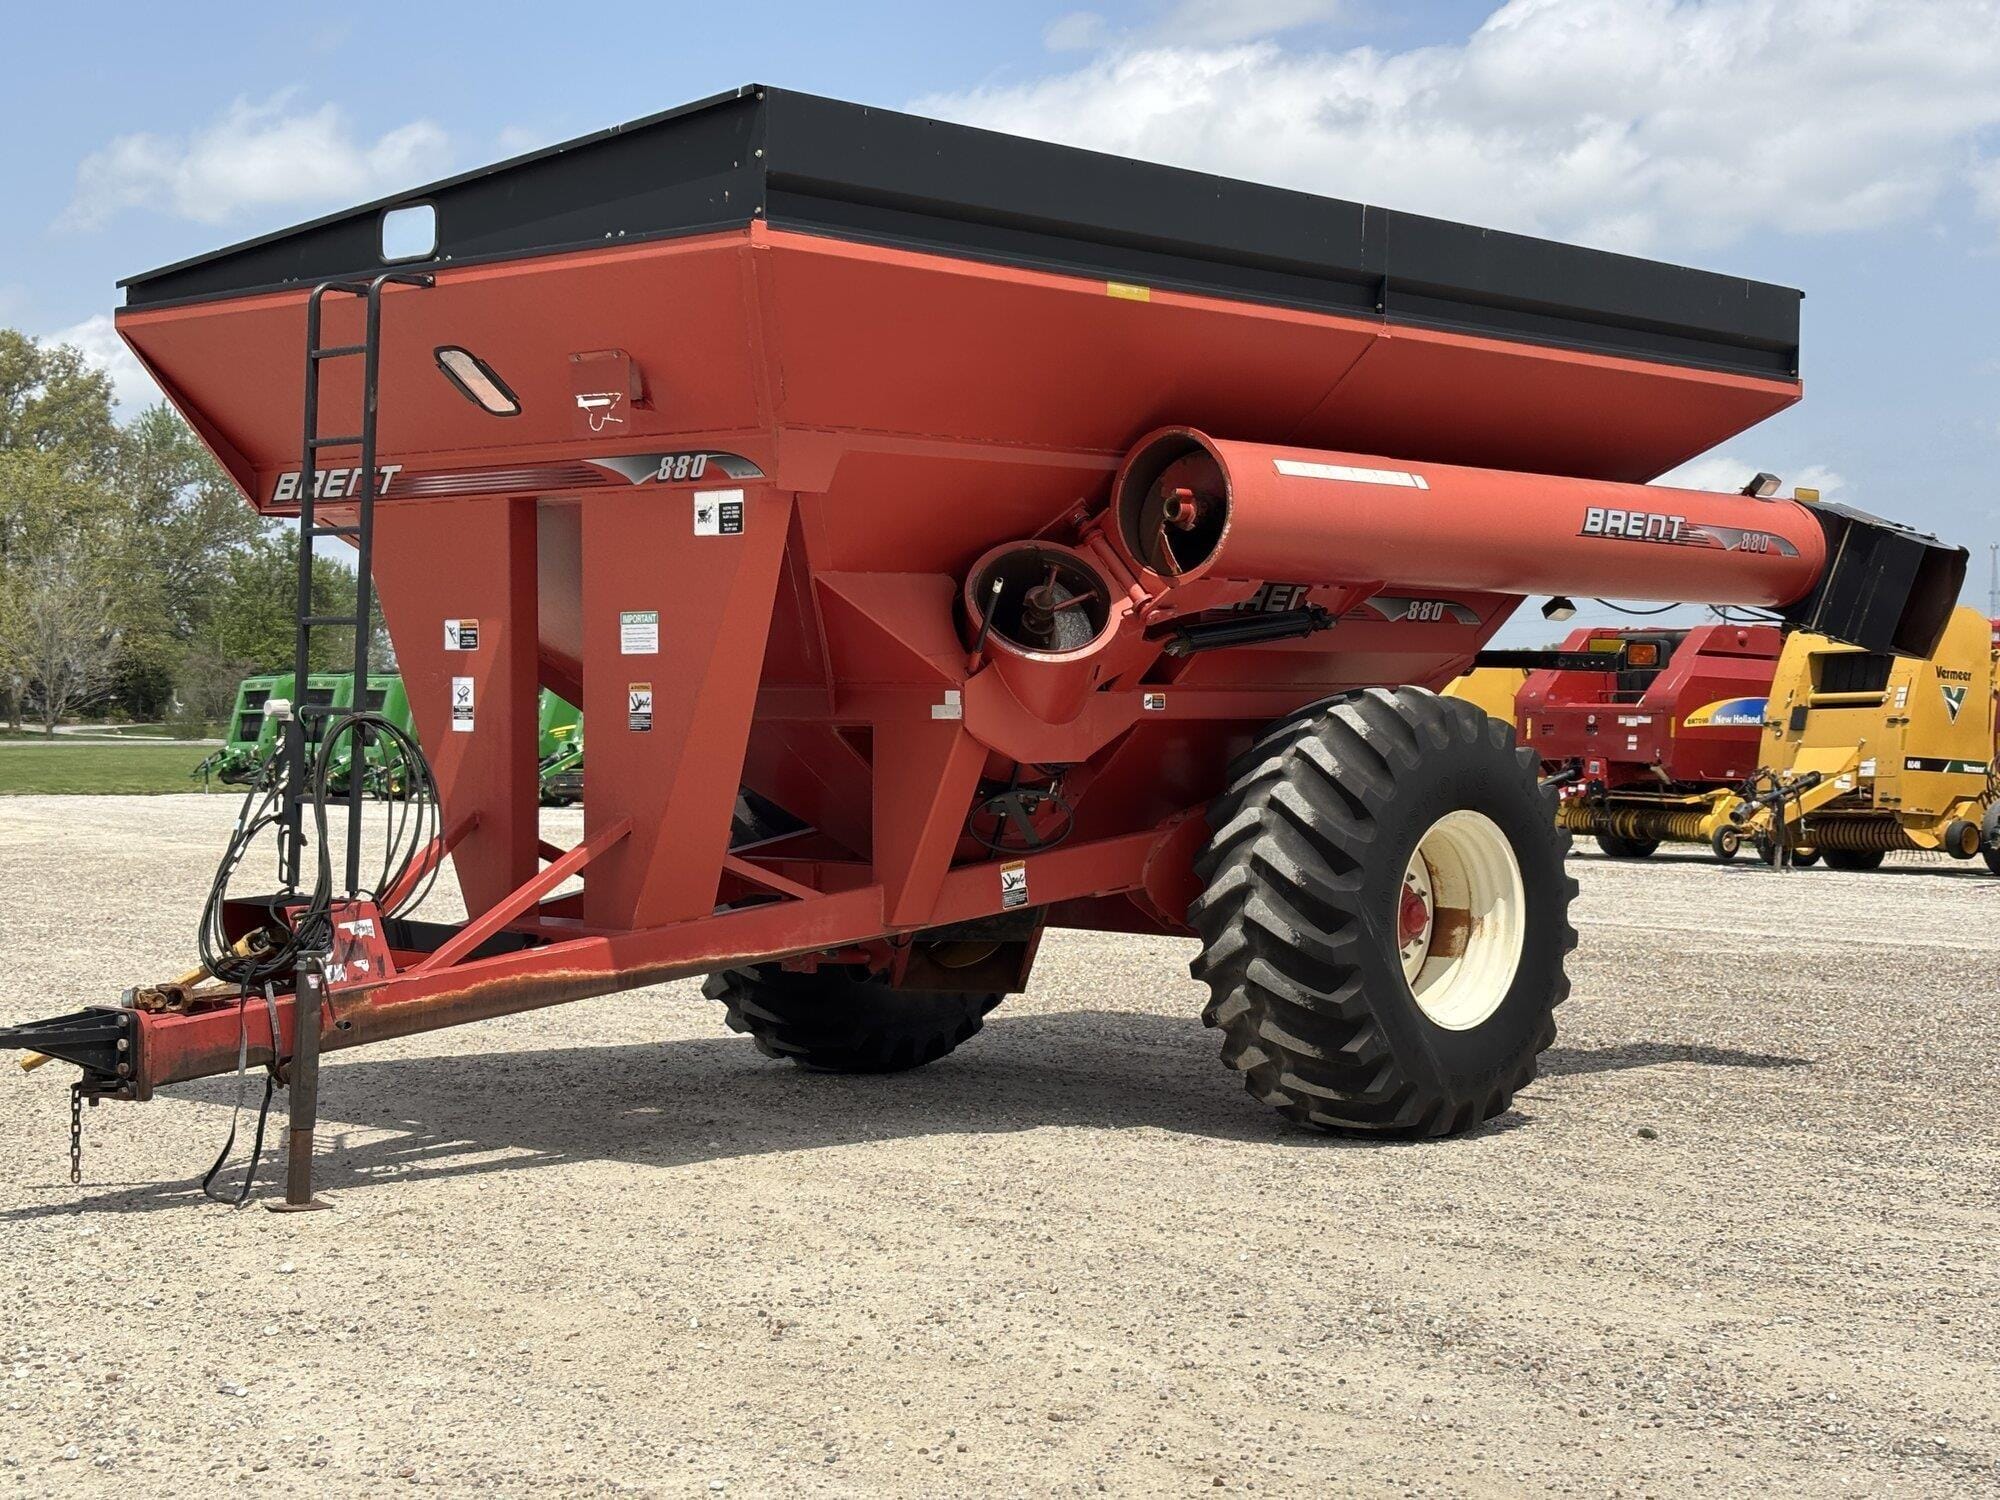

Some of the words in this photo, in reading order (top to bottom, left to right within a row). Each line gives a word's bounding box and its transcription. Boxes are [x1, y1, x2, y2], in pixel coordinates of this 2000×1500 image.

[656, 454, 708, 481] 880
[1583, 507, 1686, 541] BRENT
[1740, 532, 1769, 552] 880
[622, 613, 657, 624] IMPORTANT
[1406, 601, 1445, 621] 880
[1935, 665, 1973, 682] Vermeer
[1715, 714, 1732, 724] New
[1733, 714, 1761, 724] Holland
